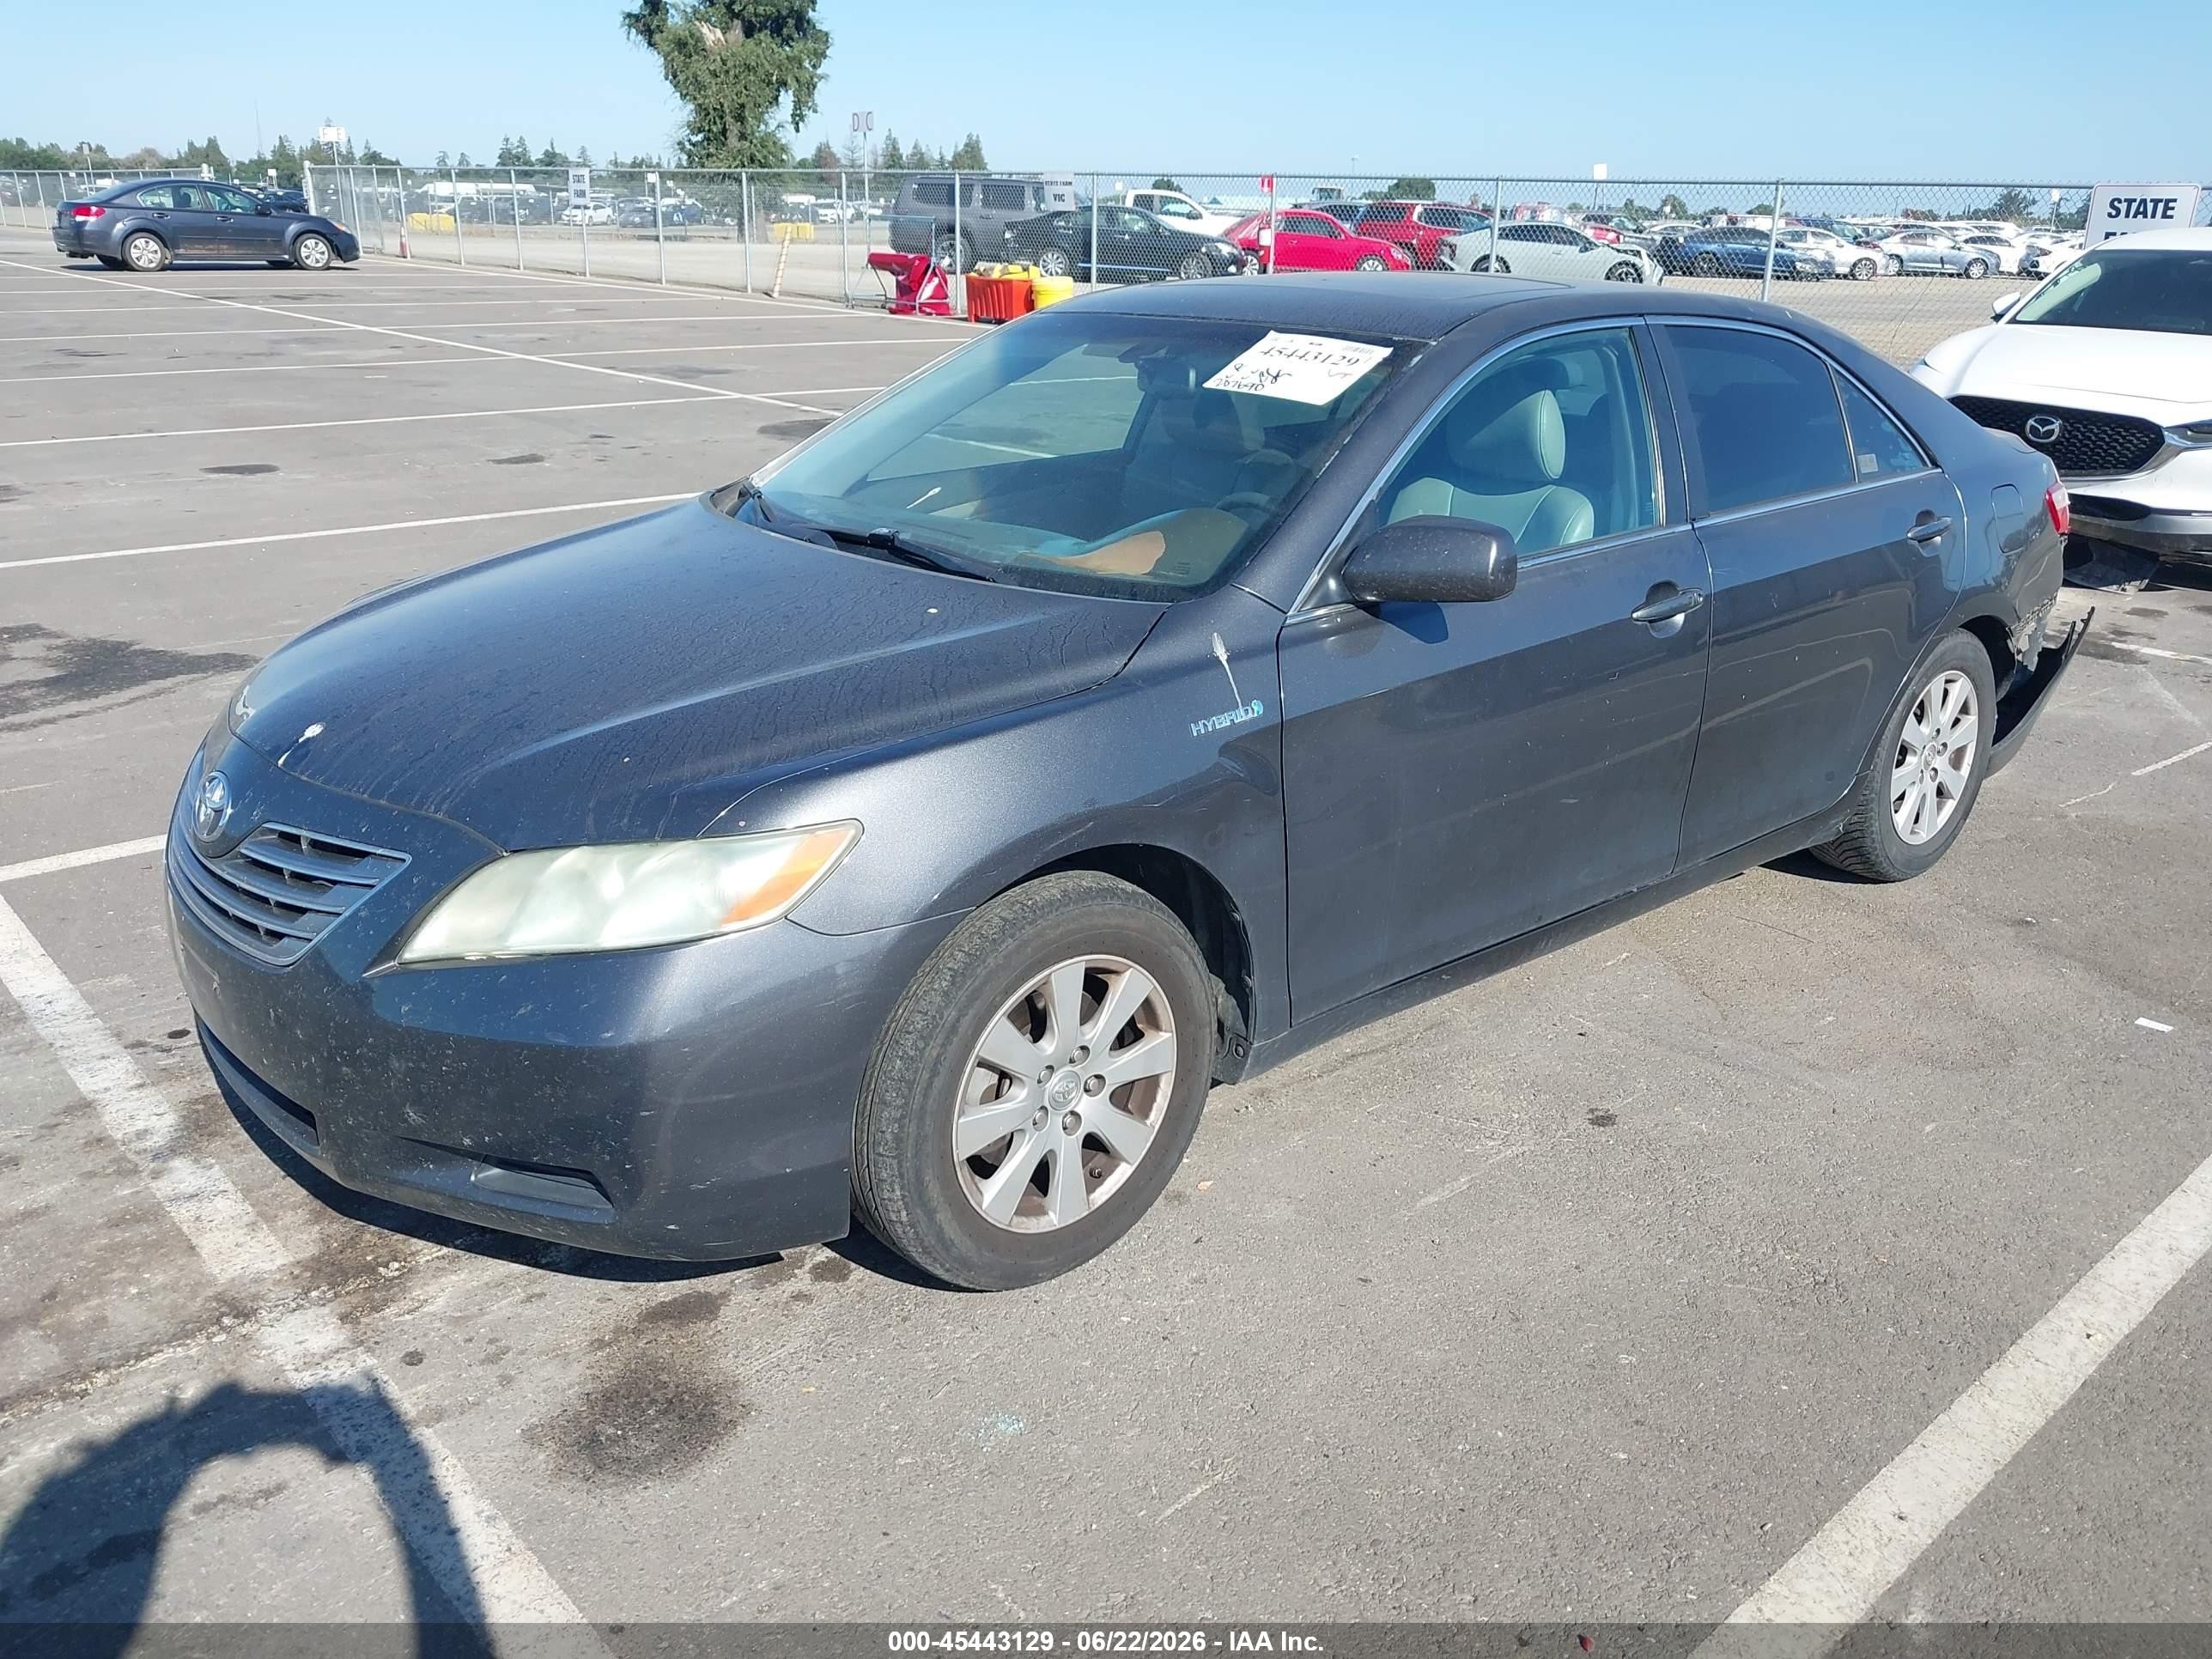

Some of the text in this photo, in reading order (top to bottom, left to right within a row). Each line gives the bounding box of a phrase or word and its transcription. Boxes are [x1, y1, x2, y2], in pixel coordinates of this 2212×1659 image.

[1052, 193, 1066, 203] VIC
[2106, 197, 2179, 220] STATE
[1260, 345, 1360, 367] 45443129
[1189, 706, 1255, 737] HYBRID
